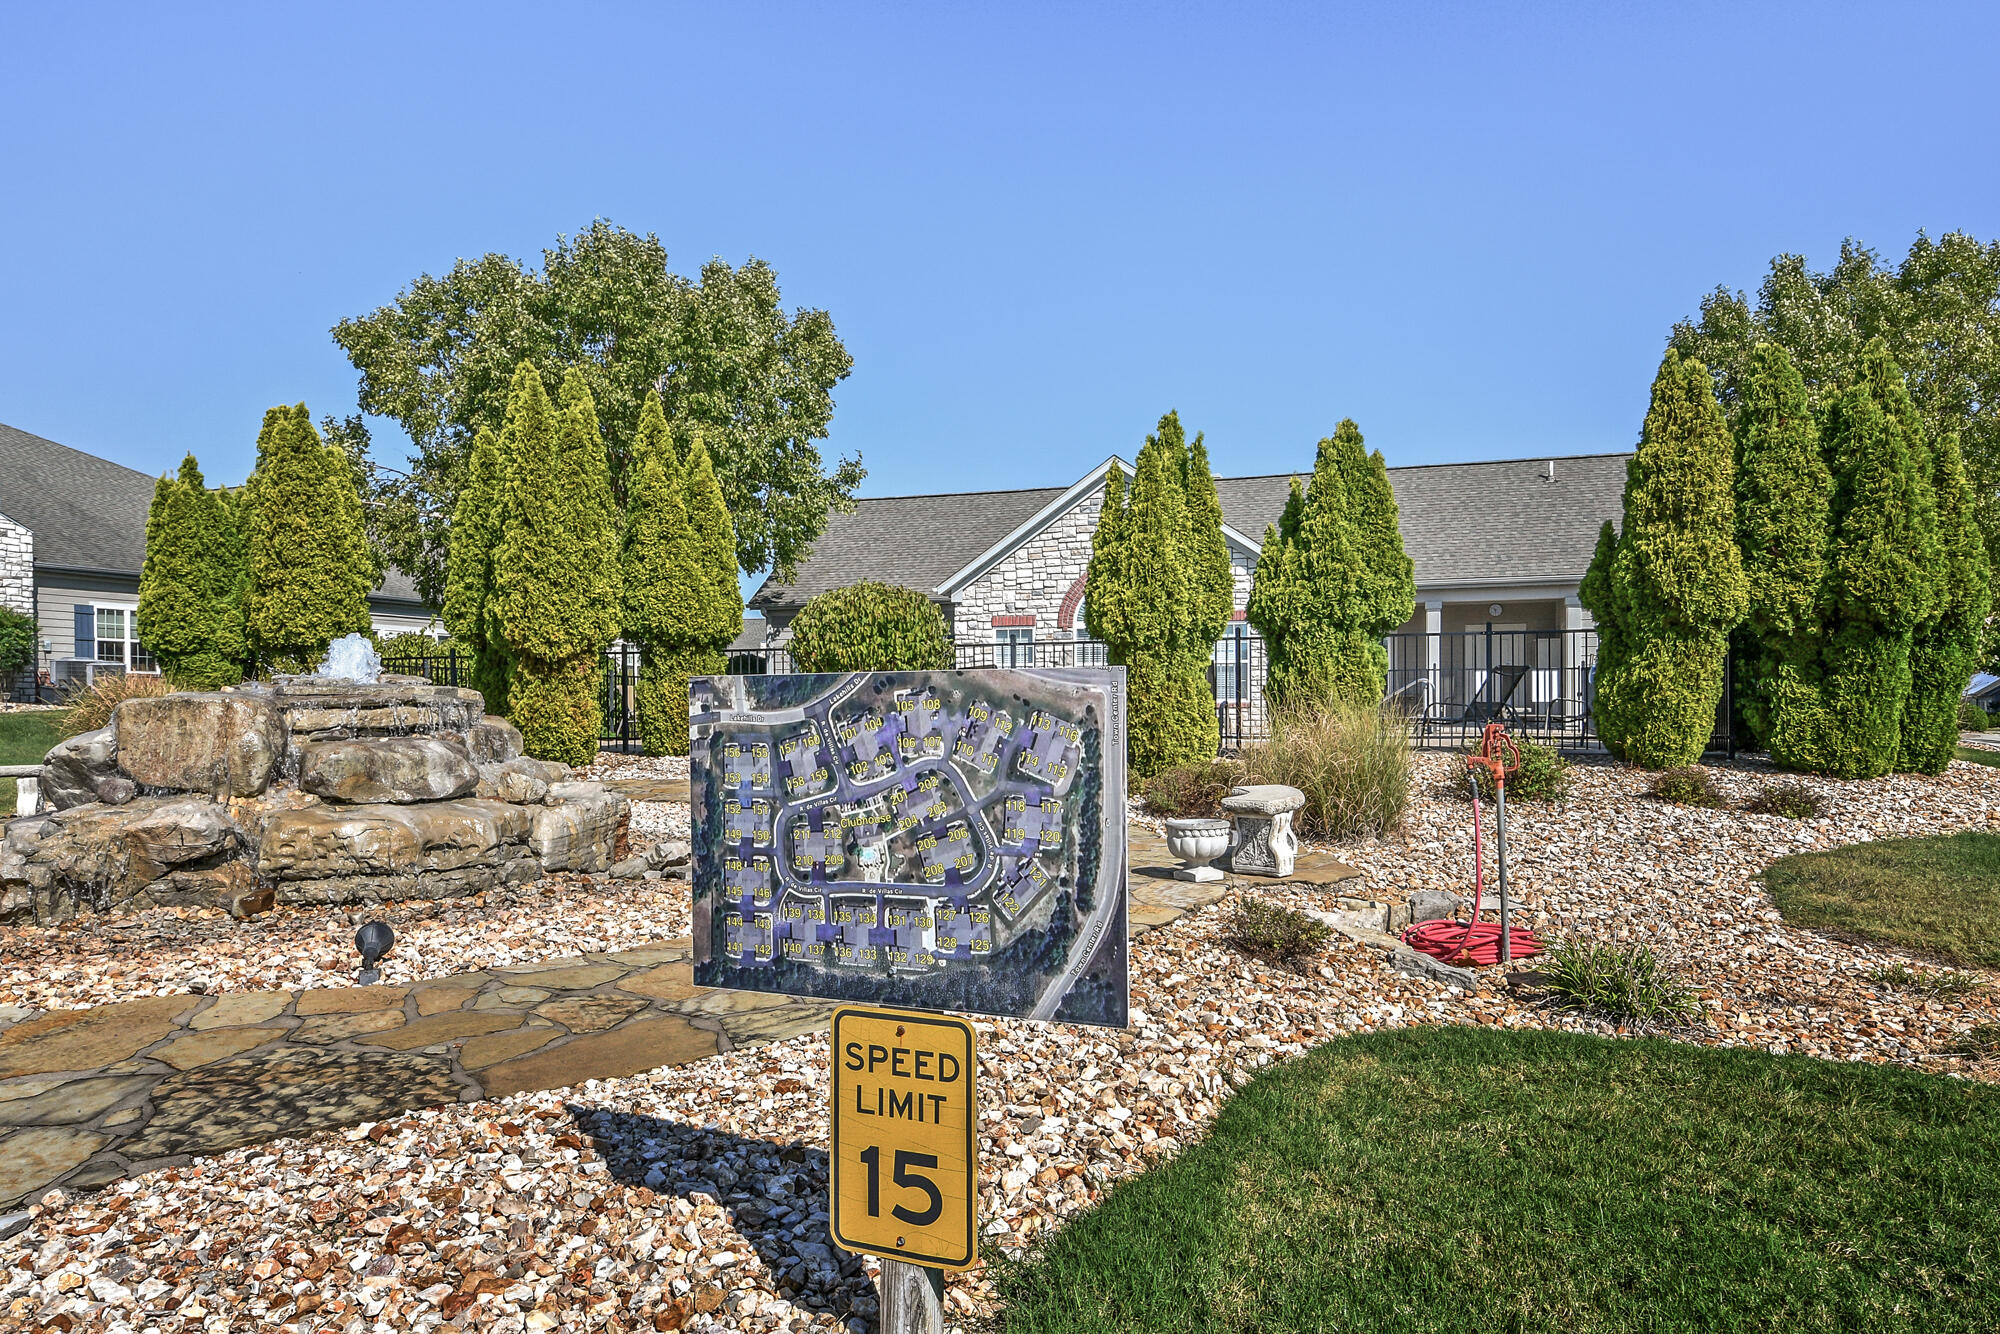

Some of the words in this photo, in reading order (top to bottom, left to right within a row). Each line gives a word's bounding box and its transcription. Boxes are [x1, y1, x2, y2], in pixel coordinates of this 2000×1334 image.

[1112, 681, 1118, 693] Rd
[829, 685, 854, 704] Lakehills
[896, 700, 914, 711] 105
[923, 699, 940, 709] 108
[969, 706, 987, 721] 109
[865, 718, 882, 731] 104
[995, 718, 1012, 733] 112
[1033, 716, 1050, 730] 113
[842, 728, 857, 739] 101
[1060, 727, 1078, 742] 116
[803, 735, 820, 747] 160
[898, 738, 915, 748] 106
[924, 736, 941, 747] 107
[725, 747, 740, 757] 156
[752, 747, 768, 757] 155
[780, 742, 796, 754] 157
[957, 741, 974, 756] 110
[875, 752, 892, 766] 103
[982, 753, 997, 768] 111
[1021, 752, 1038, 767] 114
[851, 762, 867, 774] 102
[1048, 763, 1066, 778] 115
[725, 773, 740, 782] 153
[752, 773, 768, 783] 154
[811, 770, 828, 782] 159
[788, 776, 804, 788] 158
[919, 776, 937, 792] 202
[813, 799, 828, 807] Villas
[891, 791, 908, 805] 201
[725, 804, 740, 813] 152
[752, 805, 768, 814] 151
[928, 802, 947, 817] 203
[1008, 801, 1025, 811] 118
[1041, 803, 1059, 813] 117
[840, 814, 891, 828] Clubhouse
[899, 815, 918, 830] 204
[726, 830, 742, 839] 149
[753, 831, 769, 840] 150
[794, 830, 810, 839] 211
[824, 830, 841, 839] 212
[948, 828, 968, 842] 206
[1006, 829, 1024, 839] 119
[1041, 831, 1060, 842] 120
[918, 837, 937, 851] 205
[796, 856, 813, 865] 210
[825, 855, 843, 864] 209
[955, 854, 973, 868] 207
[726, 861, 742, 871] 148
[754, 862, 769, 872] 147
[924, 864, 944, 877] 208
[1030, 867, 1046, 886] 121
[727, 886, 742, 896] 145
[754, 888, 770, 898] 146
[798, 885, 813, 893] Villas
[1002, 893, 1019, 913] 122
[785, 908, 800, 917] 139
[808, 910, 824, 920] 138
[834, 912, 851, 921] 135
[859, 913, 876, 922] 134
[938, 910, 956, 920] 127
[970, 912, 988, 923] 126
[728, 917, 743, 926] 144
[755, 920, 770, 929] 143
[889, 915, 905, 925] 131
[915, 918, 933, 928] 130
[938, 937, 956, 947] 128
[970, 940, 989, 950] 125
[728, 943, 742, 952] 141
[755, 945, 770, 954] 142
[785, 944, 801, 953] 140
[809, 945, 824, 955] 137
[835, 947, 851, 957] 136
[1070, 957, 1087, 976] Town
[1082, 933, 1098, 957] Center
[1093, 920, 1103, 933] Rd
[860, 950, 876, 960] 133
[889, 952, 906, 962] 132
[915, 955, 933, 964] 129
[845, 1042, 960, 1083] SPEED
[856, 1084, 947, 1125] LIMIT
[860, 1145, 943, 1227] 15
